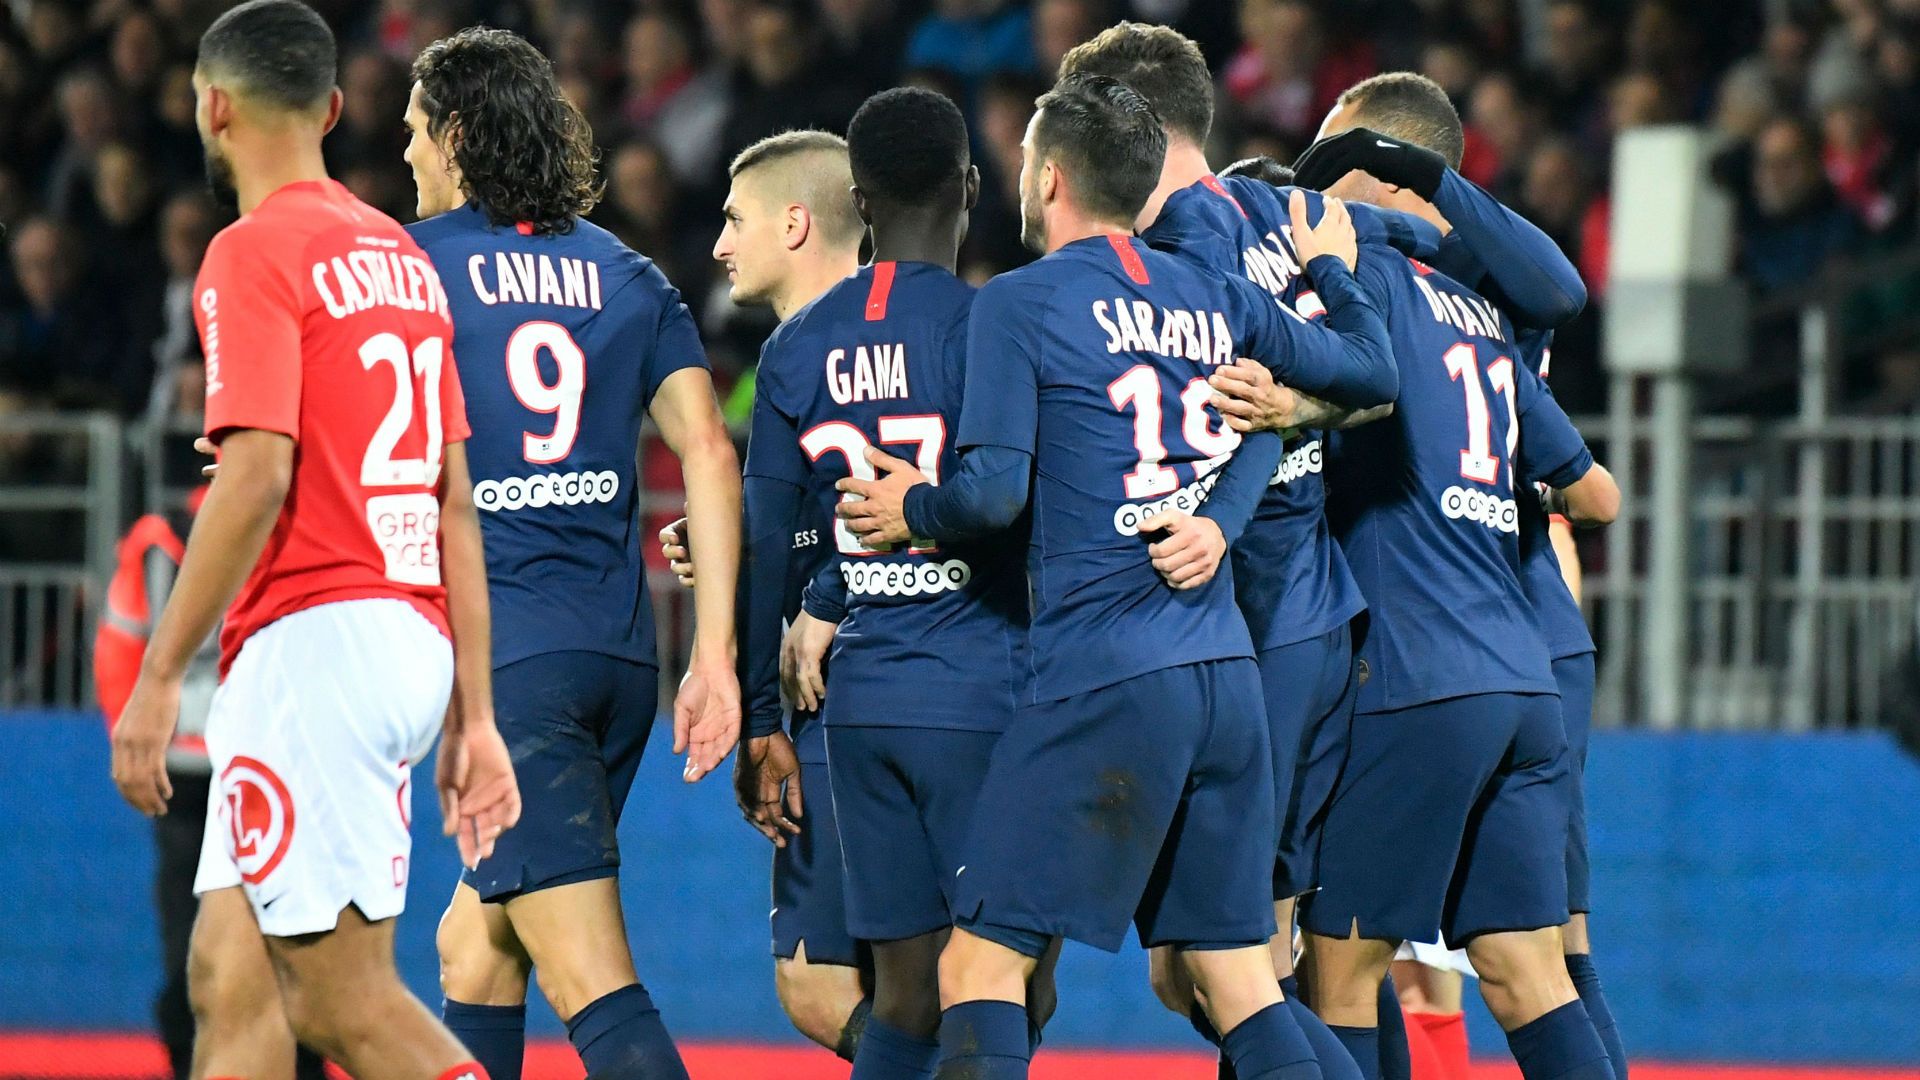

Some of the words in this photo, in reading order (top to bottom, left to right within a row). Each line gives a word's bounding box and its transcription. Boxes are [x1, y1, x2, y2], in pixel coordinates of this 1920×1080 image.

[468, 252, 602, 311] CAVANI
[1092, 297, 1233, 365] SARABIA
[505, 320, 586, 464] 9
[826, 343, 909, 405] GANA
[358, 332, 443, 488] 21
[476, 473, 616, 509] ooredoo
[377, 511, 438, 537] GRO
[792, 529, 819, 549] ESS
